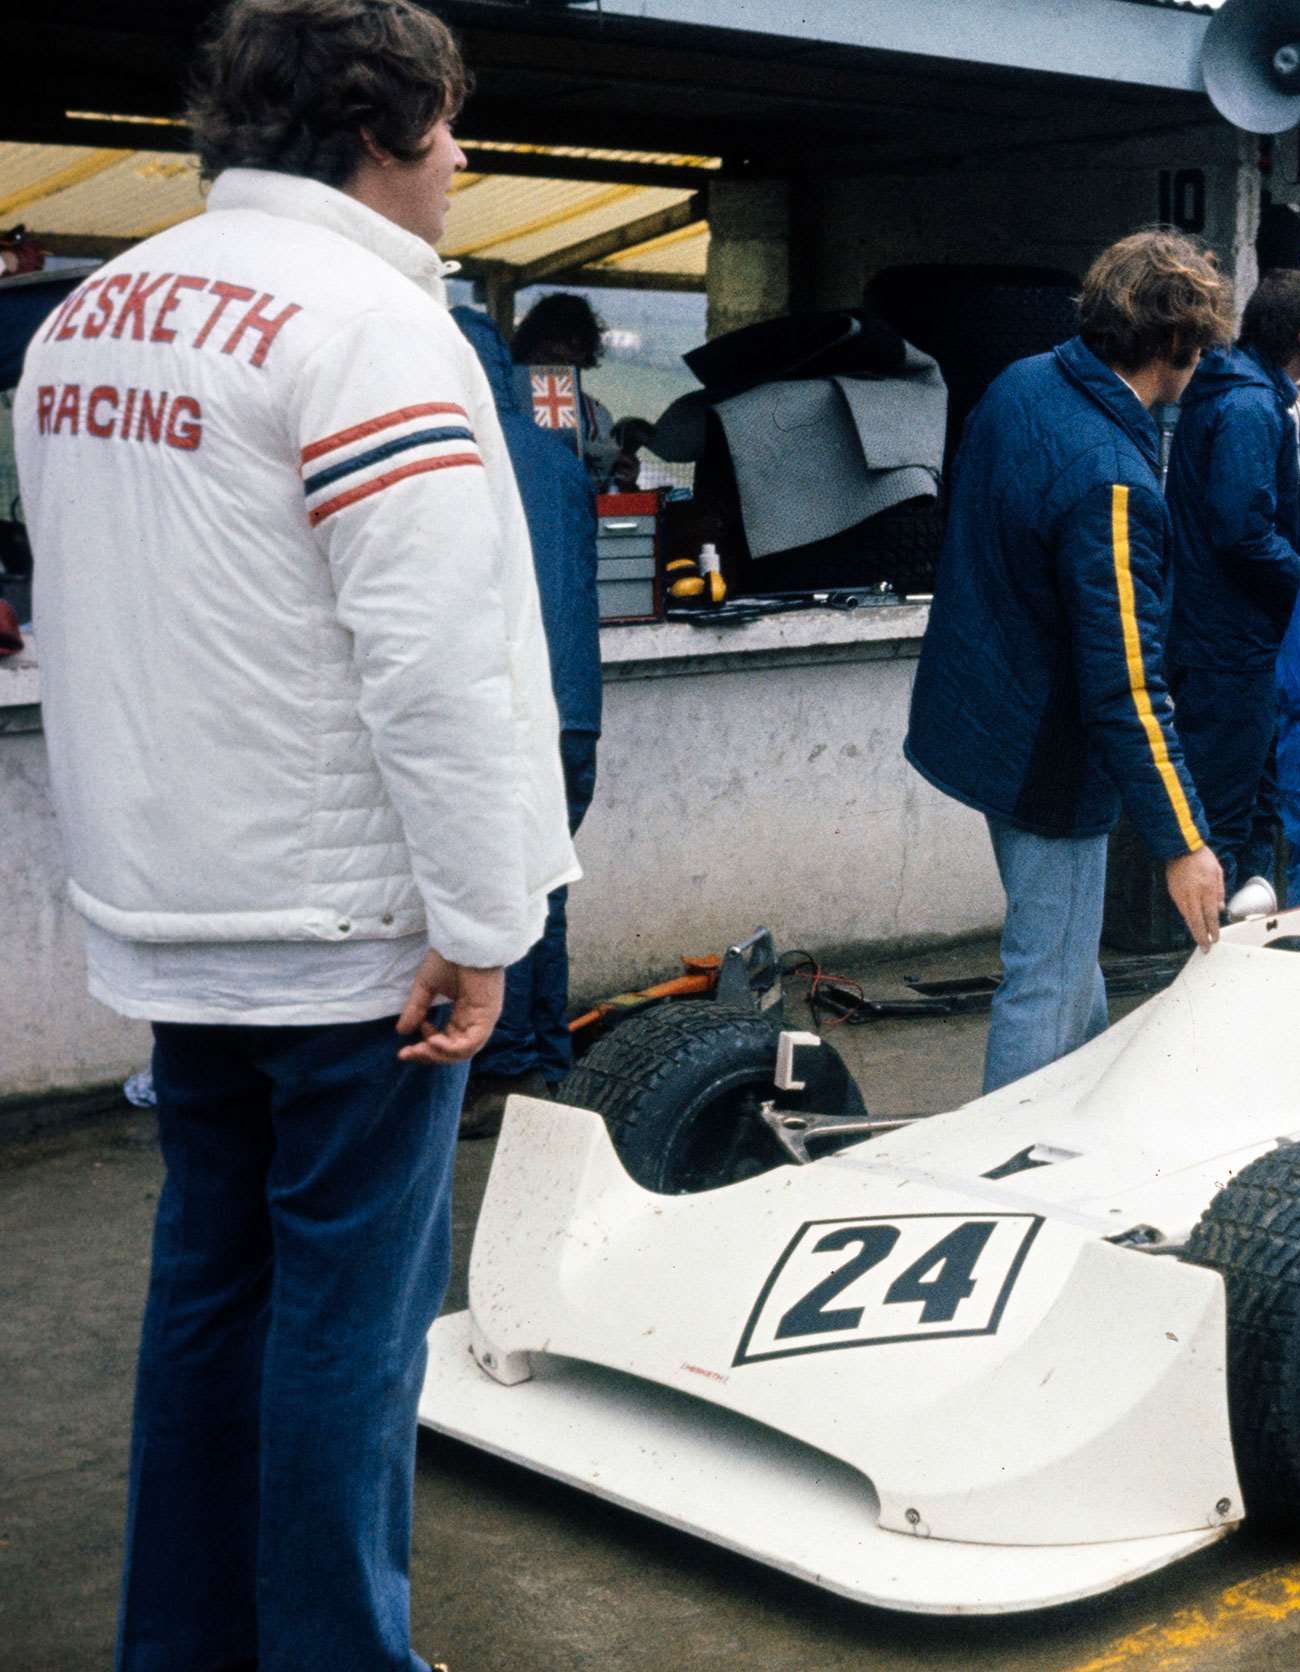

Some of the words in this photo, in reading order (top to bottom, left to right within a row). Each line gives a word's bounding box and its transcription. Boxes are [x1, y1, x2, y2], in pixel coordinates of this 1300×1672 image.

[1158, 168, 1205, 234] 10
[37, 383, 203, 451] RACING
[773, 1220, 999, 1341] 24
